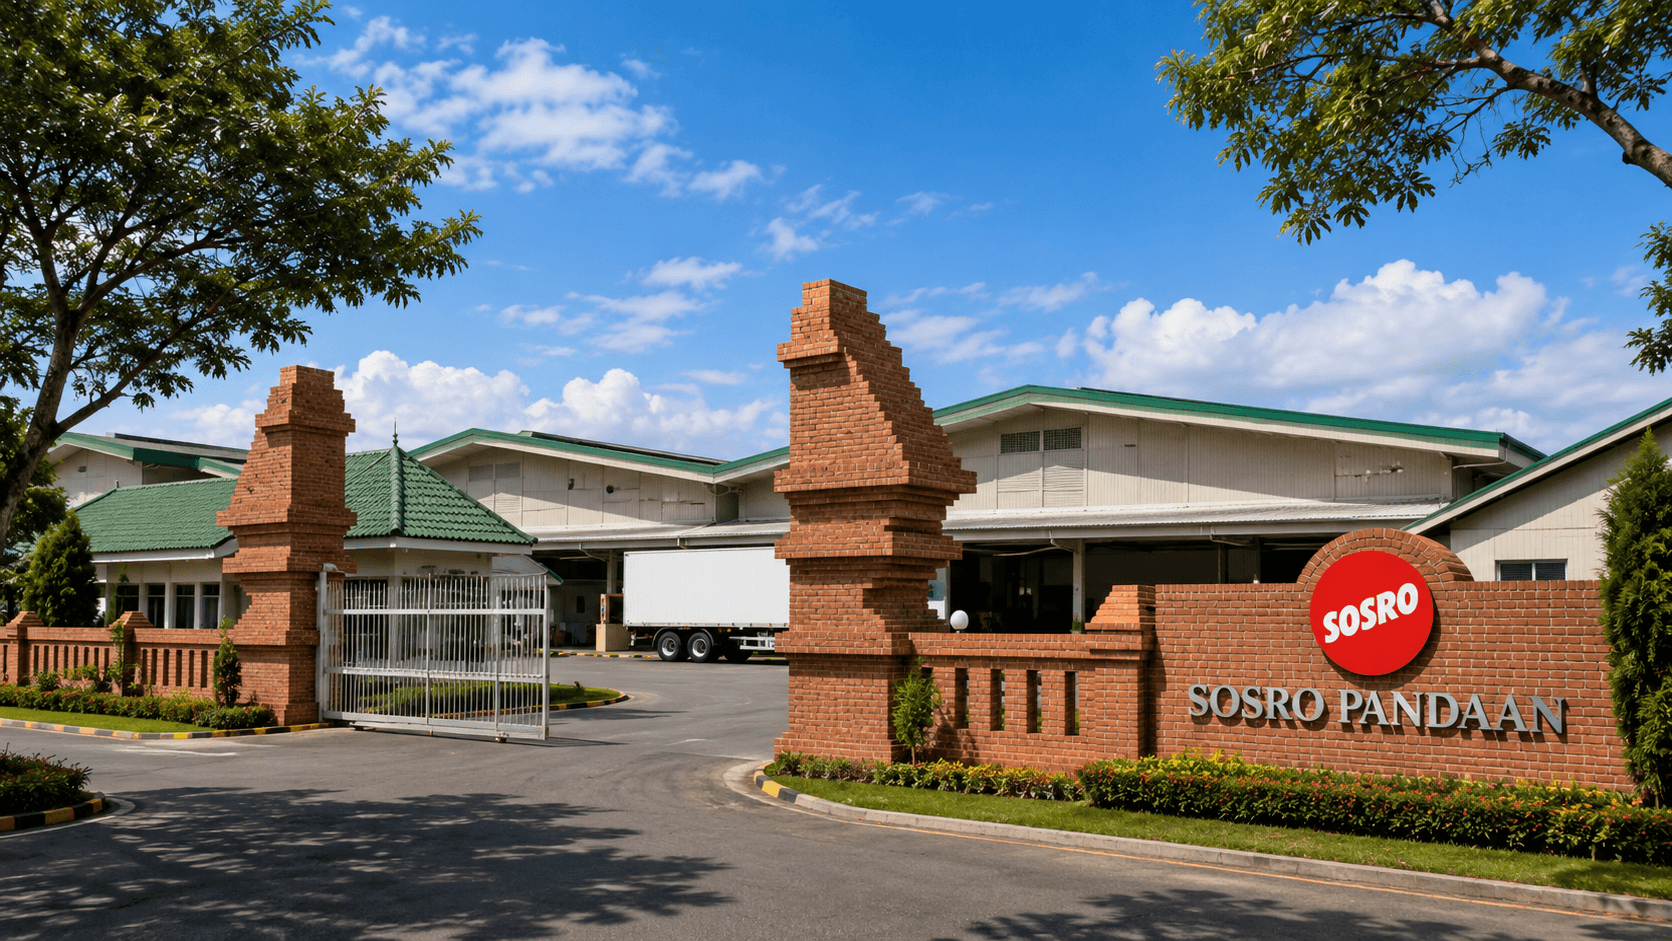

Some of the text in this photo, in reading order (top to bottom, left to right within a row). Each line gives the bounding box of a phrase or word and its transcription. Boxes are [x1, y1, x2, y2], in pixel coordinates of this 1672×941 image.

[1322, 582, 1419, 643] SOSRO
[1188, 684, 1566, 734] SOSRO PANDAAN
